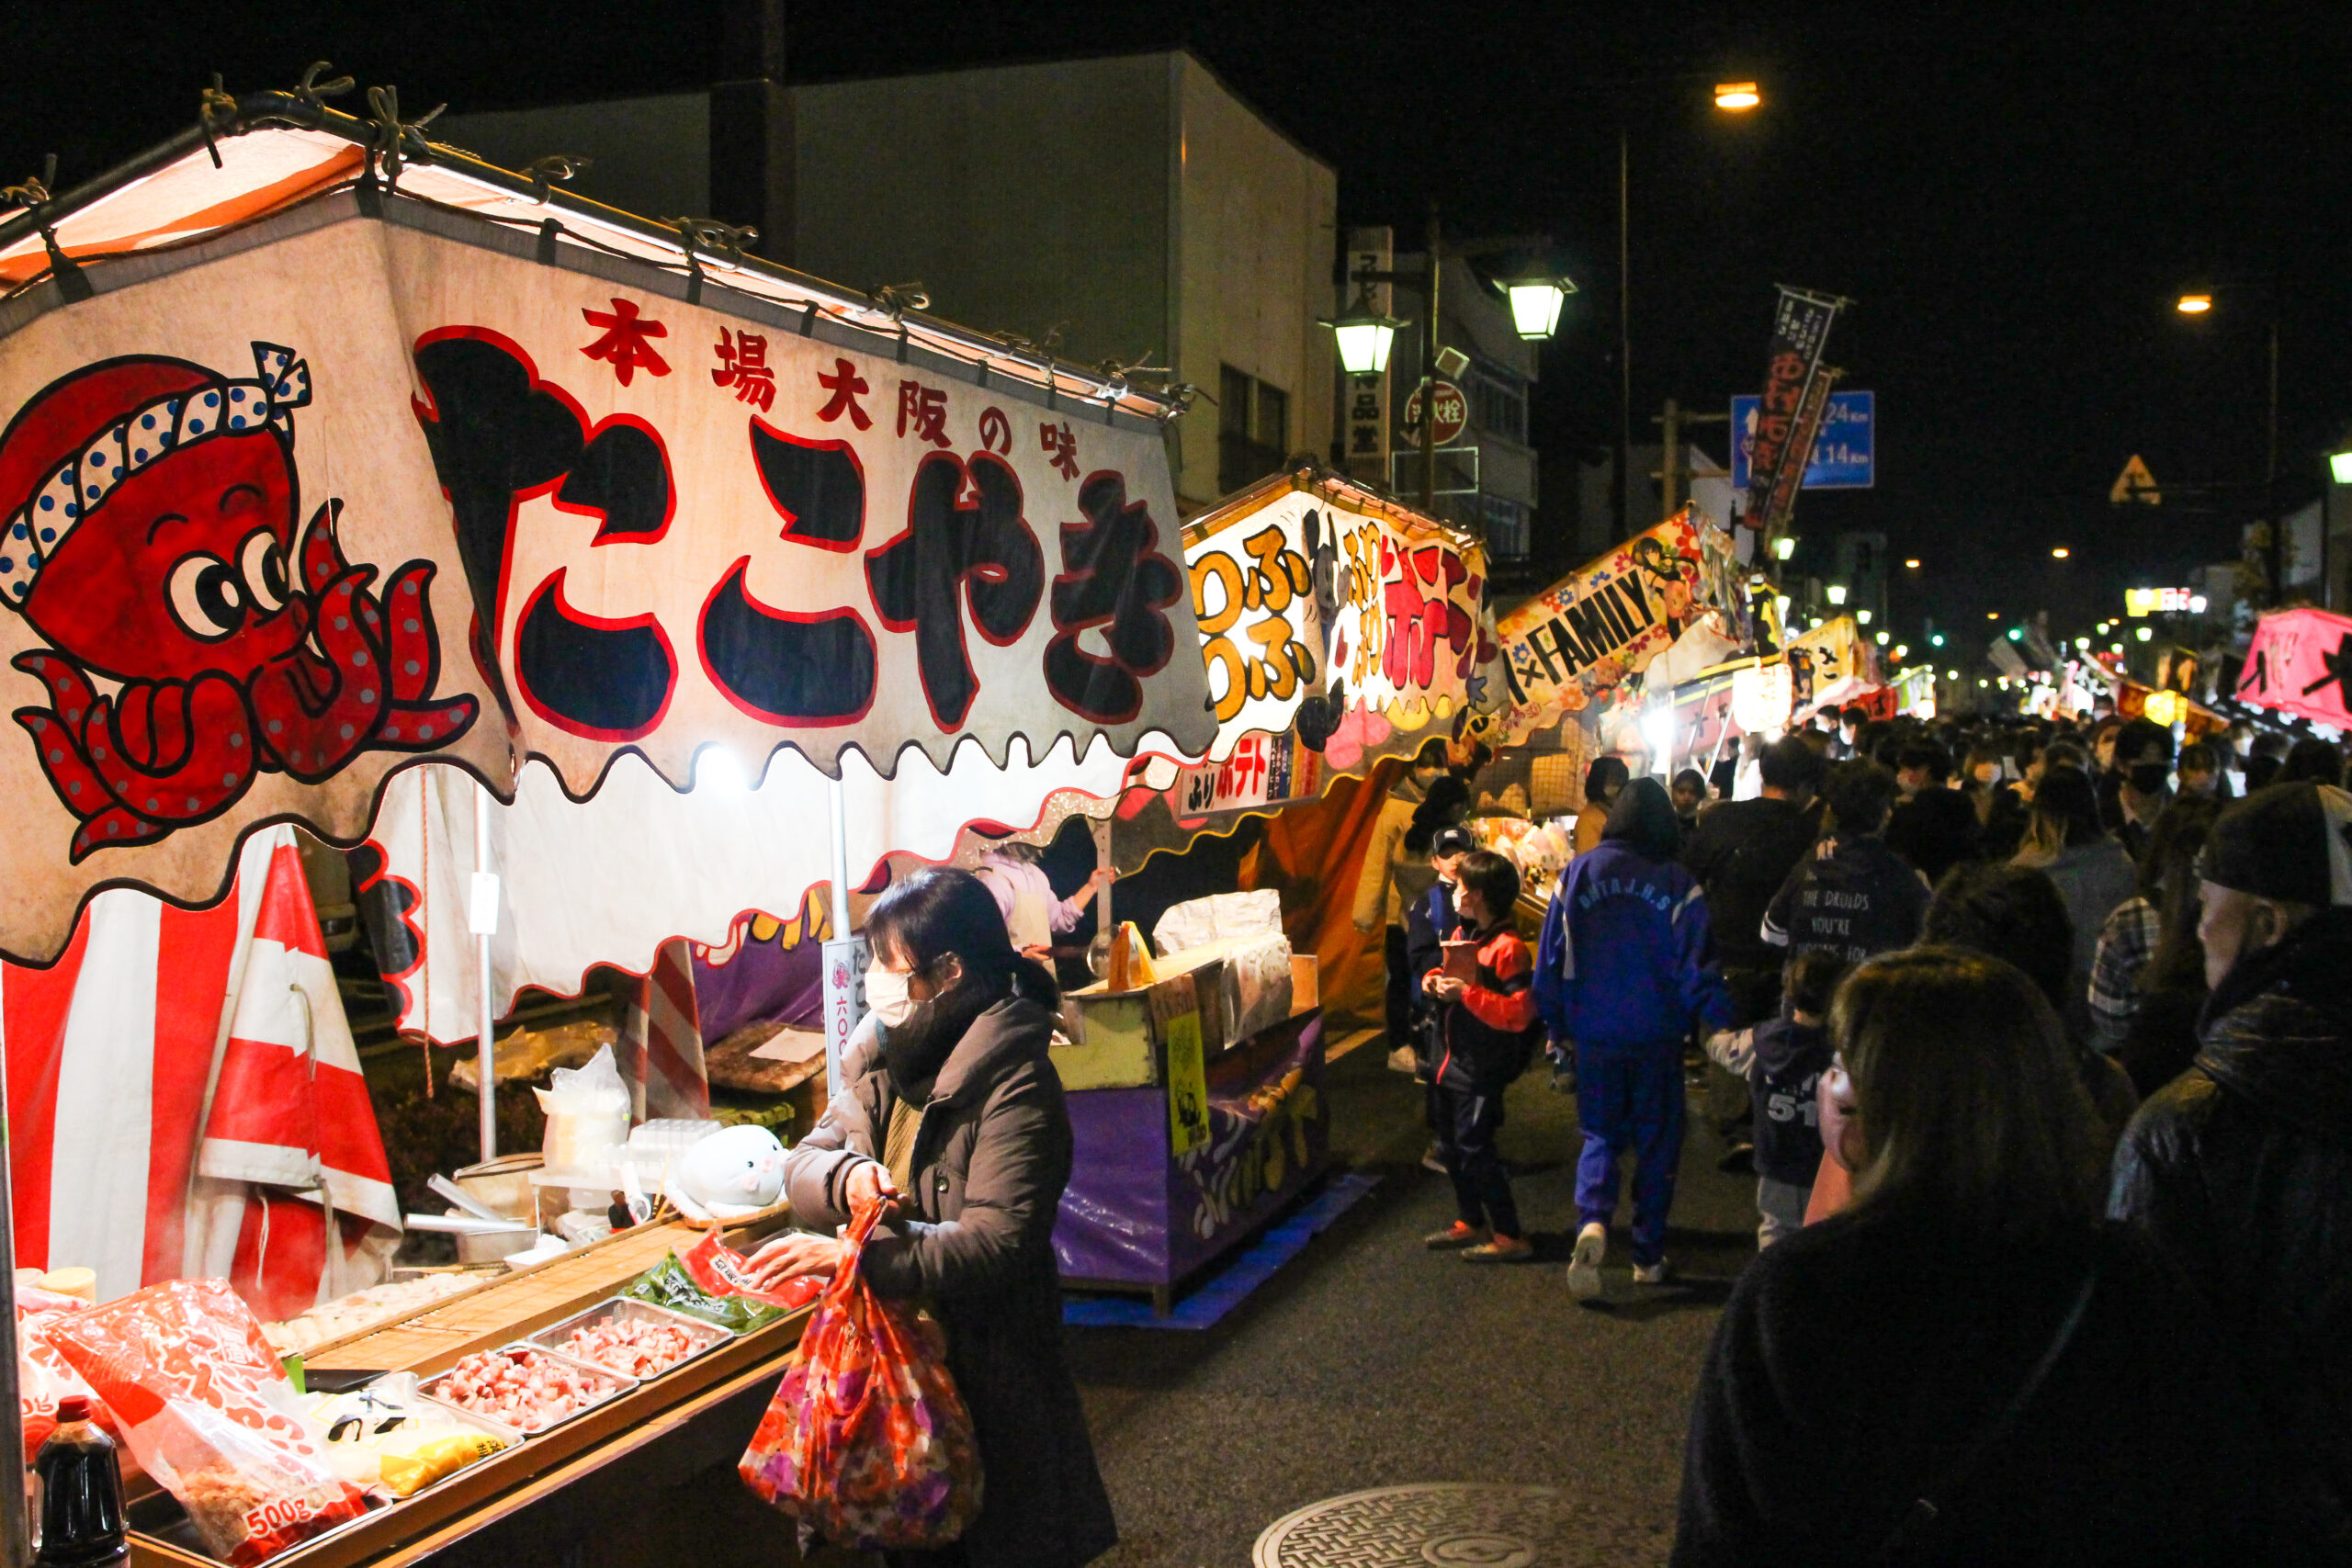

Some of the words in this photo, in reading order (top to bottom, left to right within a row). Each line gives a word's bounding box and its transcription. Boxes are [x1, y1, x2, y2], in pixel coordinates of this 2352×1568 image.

[581, 298, 1080, 481] 本場大阪の味
[1825, 402, 1848, 424] 24
[1826, 443, 1848, 464] 14
[411, 325, 1183, 744] たこやき
[246, 1498, 312, 1536] 500g
